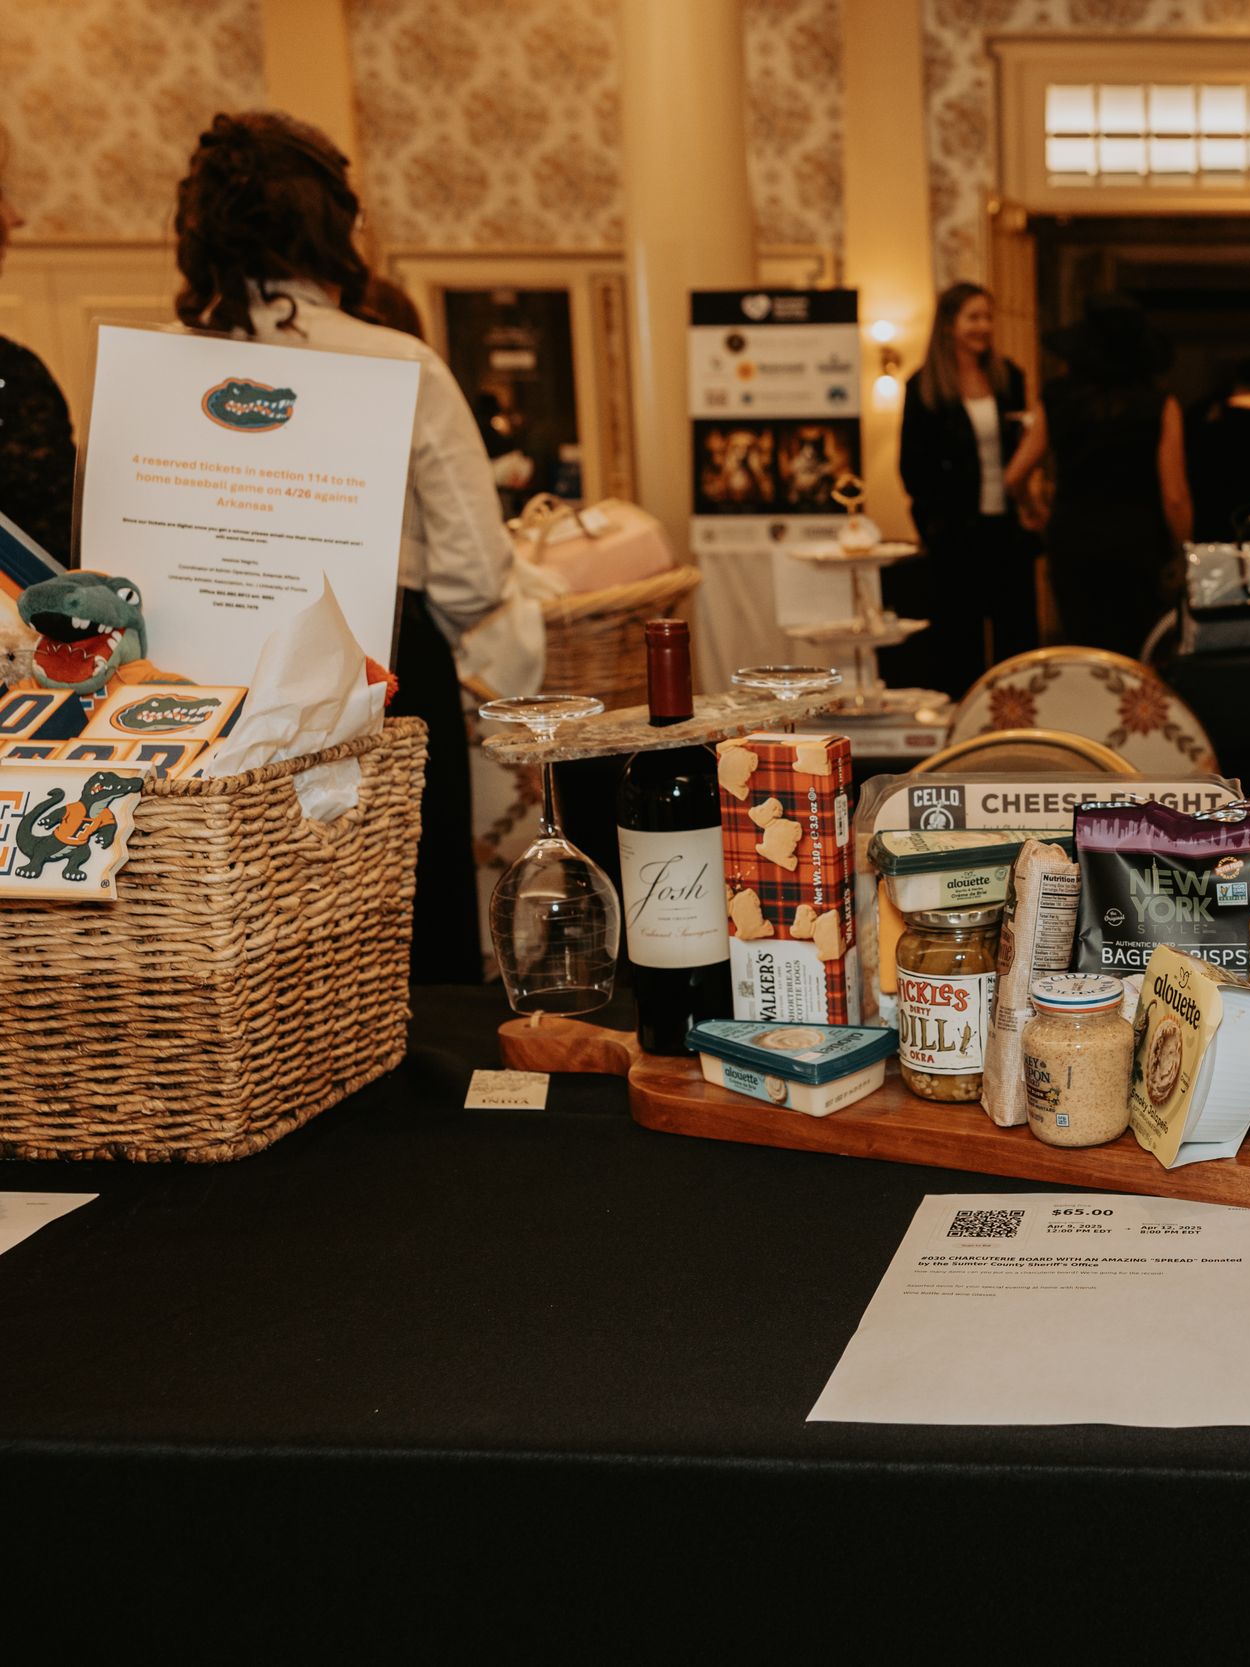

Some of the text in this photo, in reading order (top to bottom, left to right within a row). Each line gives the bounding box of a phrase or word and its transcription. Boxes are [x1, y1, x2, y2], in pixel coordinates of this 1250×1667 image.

[142, 456, 366, 488] reserved tickets in section 114 to the
[135, 471, 358, 505] home baseball game on 4/26 against
[217, 497, 274, 513] Arkansas
[913, 787, 960, 807] CELLO
[809, 801, 823, 905] Net Wt. 110 3.9 oz
[946, 875, 991, 890] alouette
[1043, 874, 1076, 883] Nutrition
[1129, 858, 1211, 896] NEW
[627, 855, 710, 930] Josh
[1130, 895, 1215, 923] YORK
[1137, 924, 1201, 934] STYLE
[793, 959, 802, 985] DOGS
[909, 1004, 931, 1016] DIRTY
[1154, 973, 1201, 1031] alouette
[900, 1008, 956, 1052] DILL
[910, 1050, 935, 1064] OKRA
[724, 1066, 759, 1086] alouette
[1130, 1087, 1148, 1113] Smoky
[1052, 1208, 1114, 1217] $65.00
